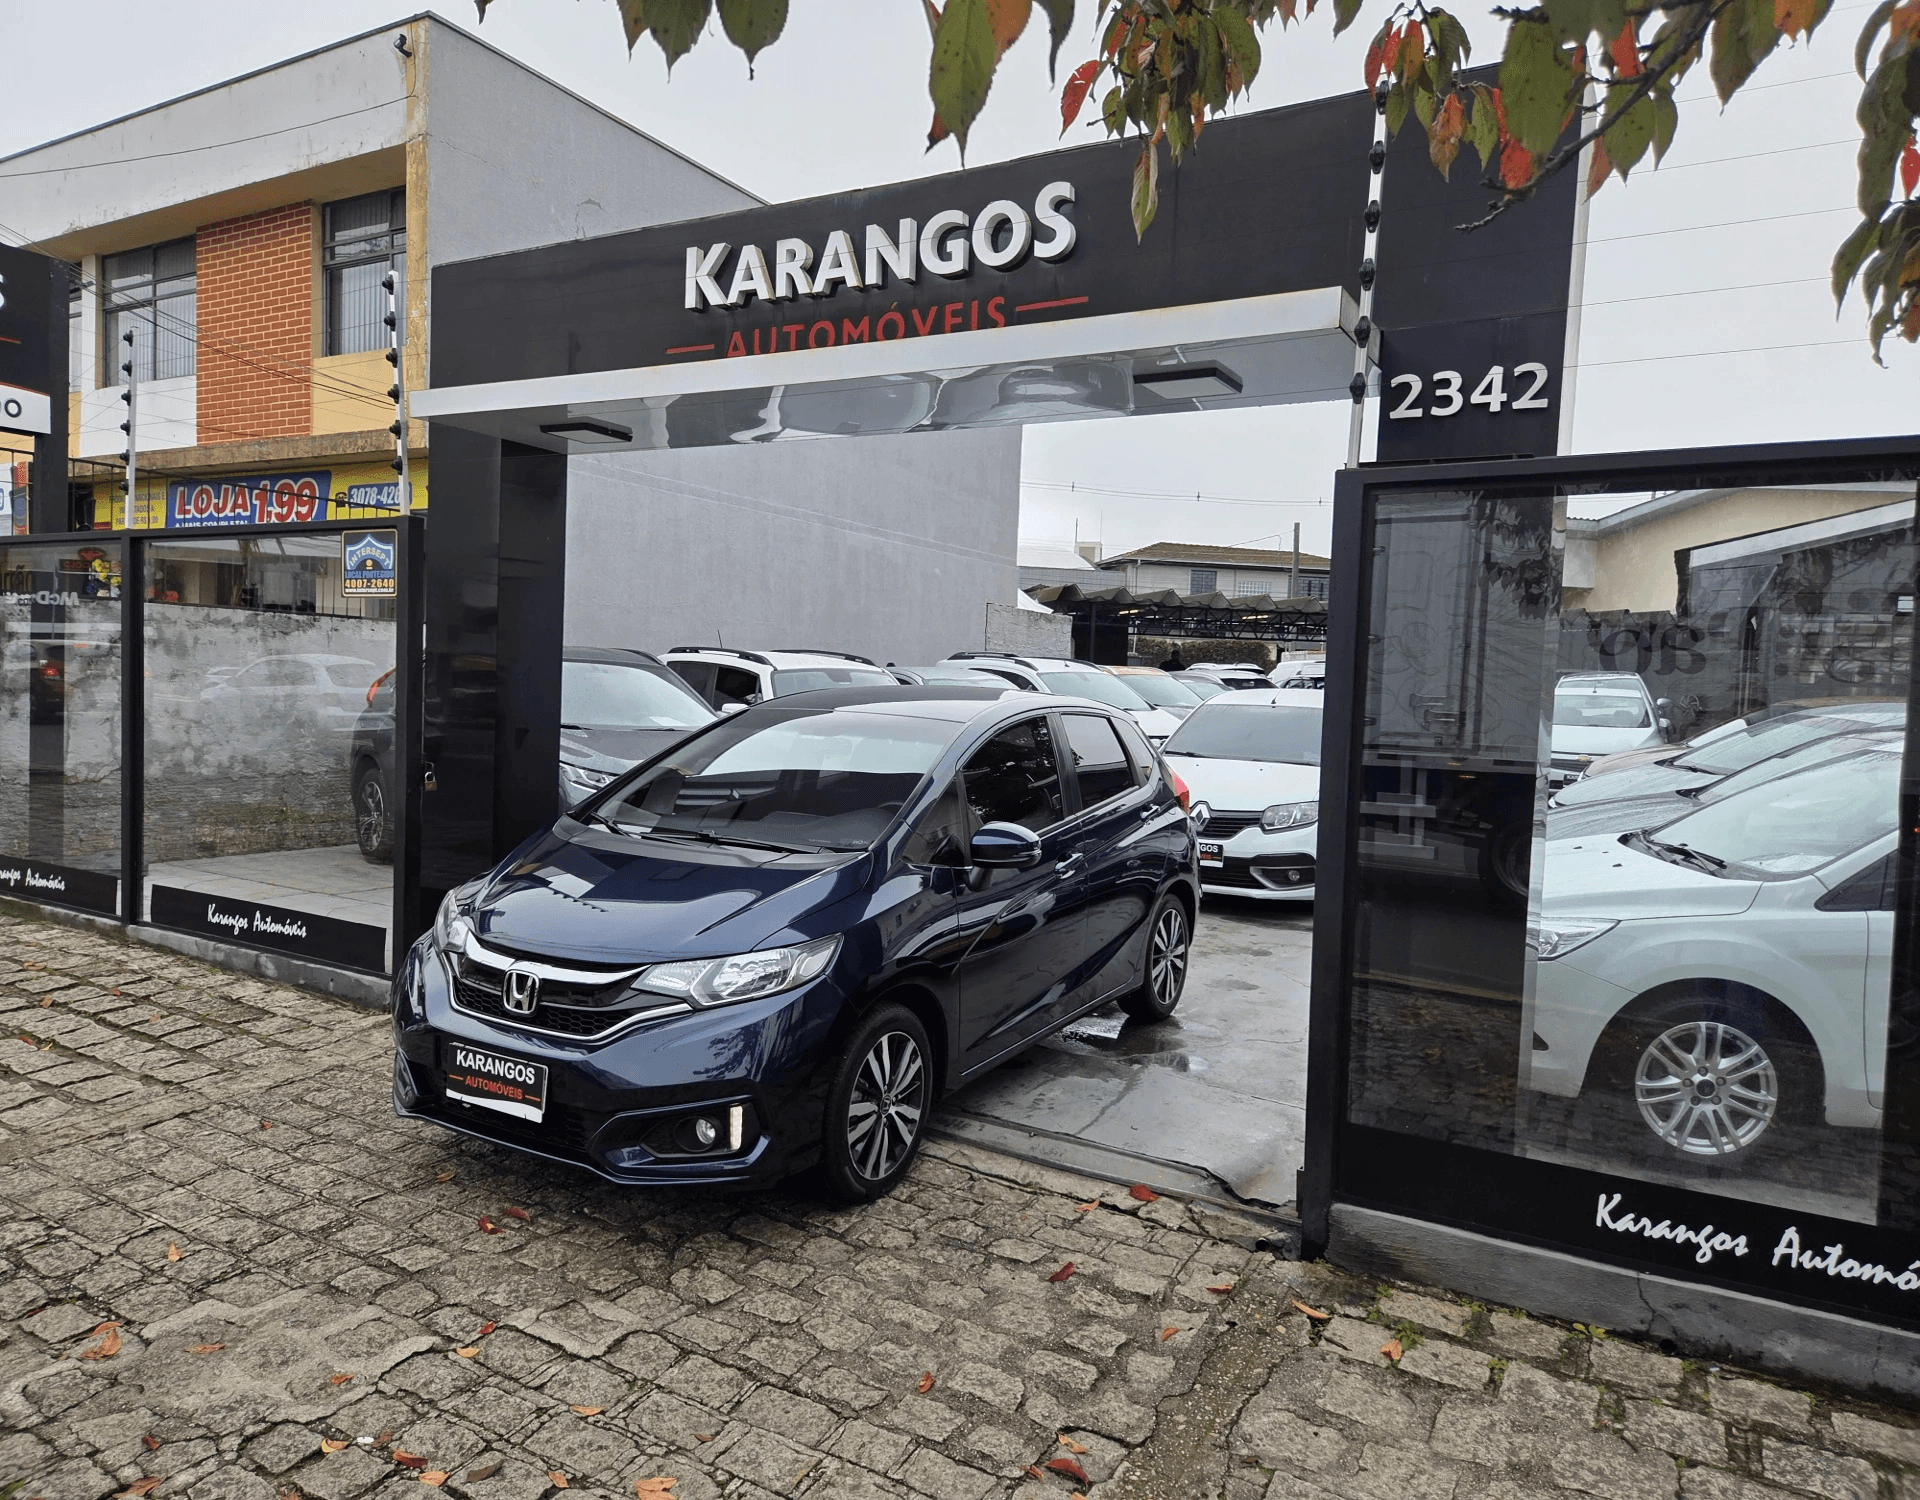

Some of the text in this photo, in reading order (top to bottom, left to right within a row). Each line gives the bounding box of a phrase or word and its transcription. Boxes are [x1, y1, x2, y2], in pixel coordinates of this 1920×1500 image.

[684, 181, 1076, 312] KARANGOS
[726, 296, 1006, 358] AUTOMÓVEIS
[1389, 362, 1549, 420] 2342
[175, 483, 250, 519] LOJA
[349, 546, 391, 567] INTERSEPT
[345, 579, 395, 588] 4007-2640
[1200, 844, 1219, 853] GOS
[207, 903, 307, 939] Karangos Automóveis
[456, 1049, 536, 1085] KARANGOS
[465, 1075, 524, 1100] AUTOMÓVEIS
[1596, 1193, 1749, 1264] Karangos
